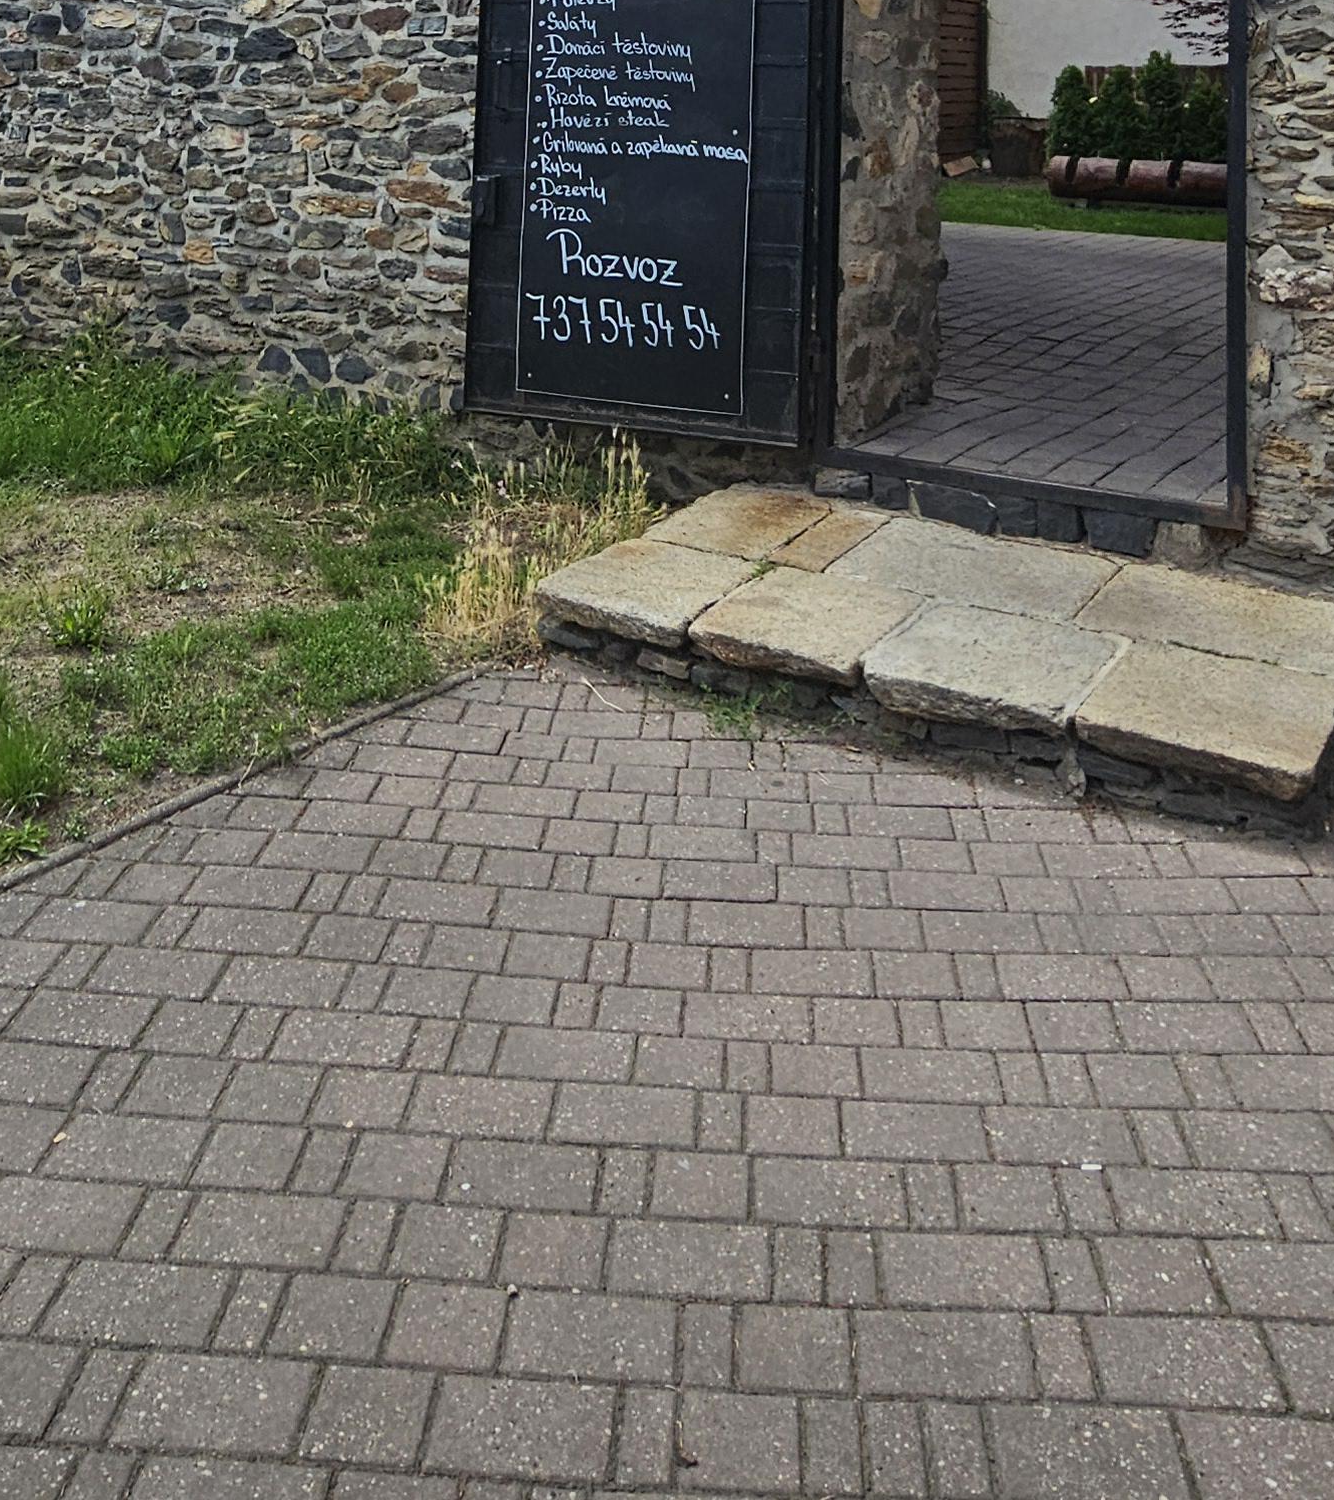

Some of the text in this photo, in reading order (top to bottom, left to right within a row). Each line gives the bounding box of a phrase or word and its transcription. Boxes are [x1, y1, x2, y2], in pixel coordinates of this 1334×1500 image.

[547, 11, 597, 38] Saláty
[544, 31, 693, 66] Domácí těstoviny
[625, 59, 696, 92] těstoviny
[541, 83, 672, 112] Rizota krémová
[550, 106, 670, 129] Hovězí steak
[538, 153, 583, 180] Ryby
[611, 143, 622, 156] a
[703, 144, 750, 164] masa
[536, 177, 607, 205] Dezerty
[536, 198, 592, 223] Pizza
[546, 228, 684, 286] Rozvoz
[525, 292, 591, 344] 737
